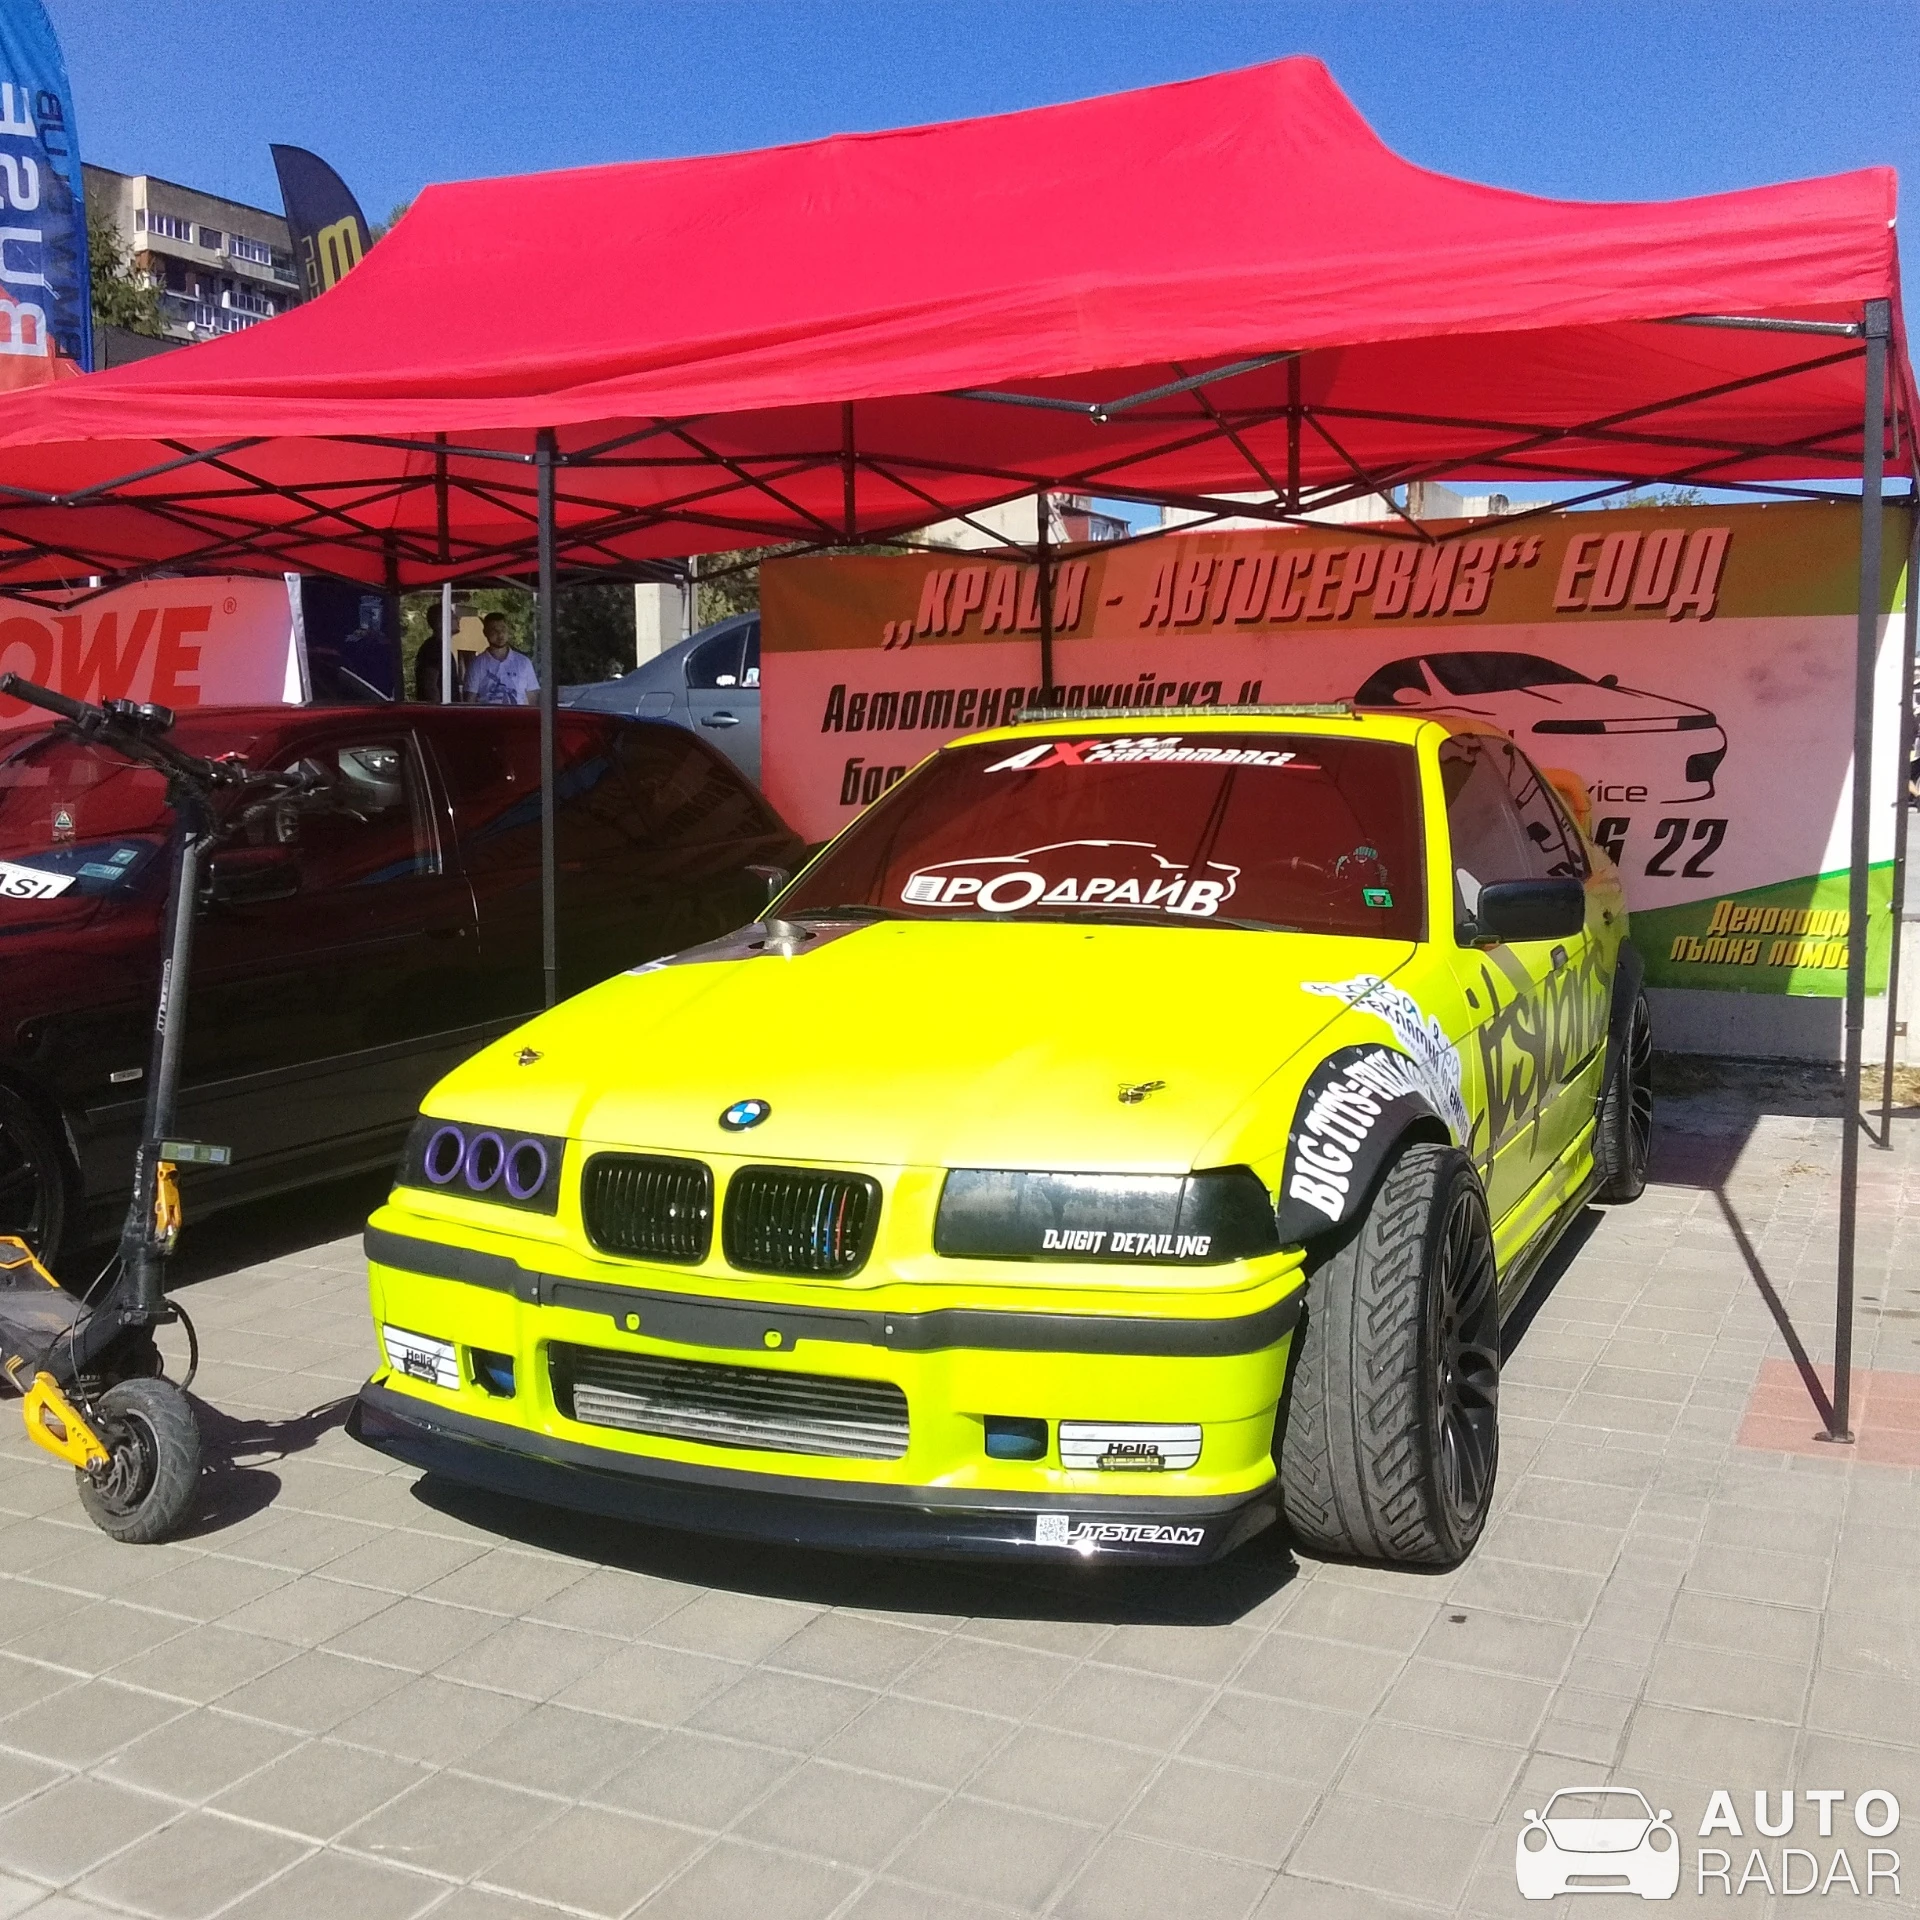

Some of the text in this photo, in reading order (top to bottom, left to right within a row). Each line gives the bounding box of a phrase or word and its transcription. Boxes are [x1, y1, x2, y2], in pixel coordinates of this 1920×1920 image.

[1552, 527, 1734, 623] ЕООД
[1644, 817, 1729, 879] 22
[1706, 899, 1850, 942] Денонощн
[1042, 1229, 1212, 1259] DJIGIT DETAILING
[405, 1348, 433, 1367] Hella
[1107, 1442, 1159, 1456] Hella
[1068, 1522, 1205, 1546] JTSTEAM
